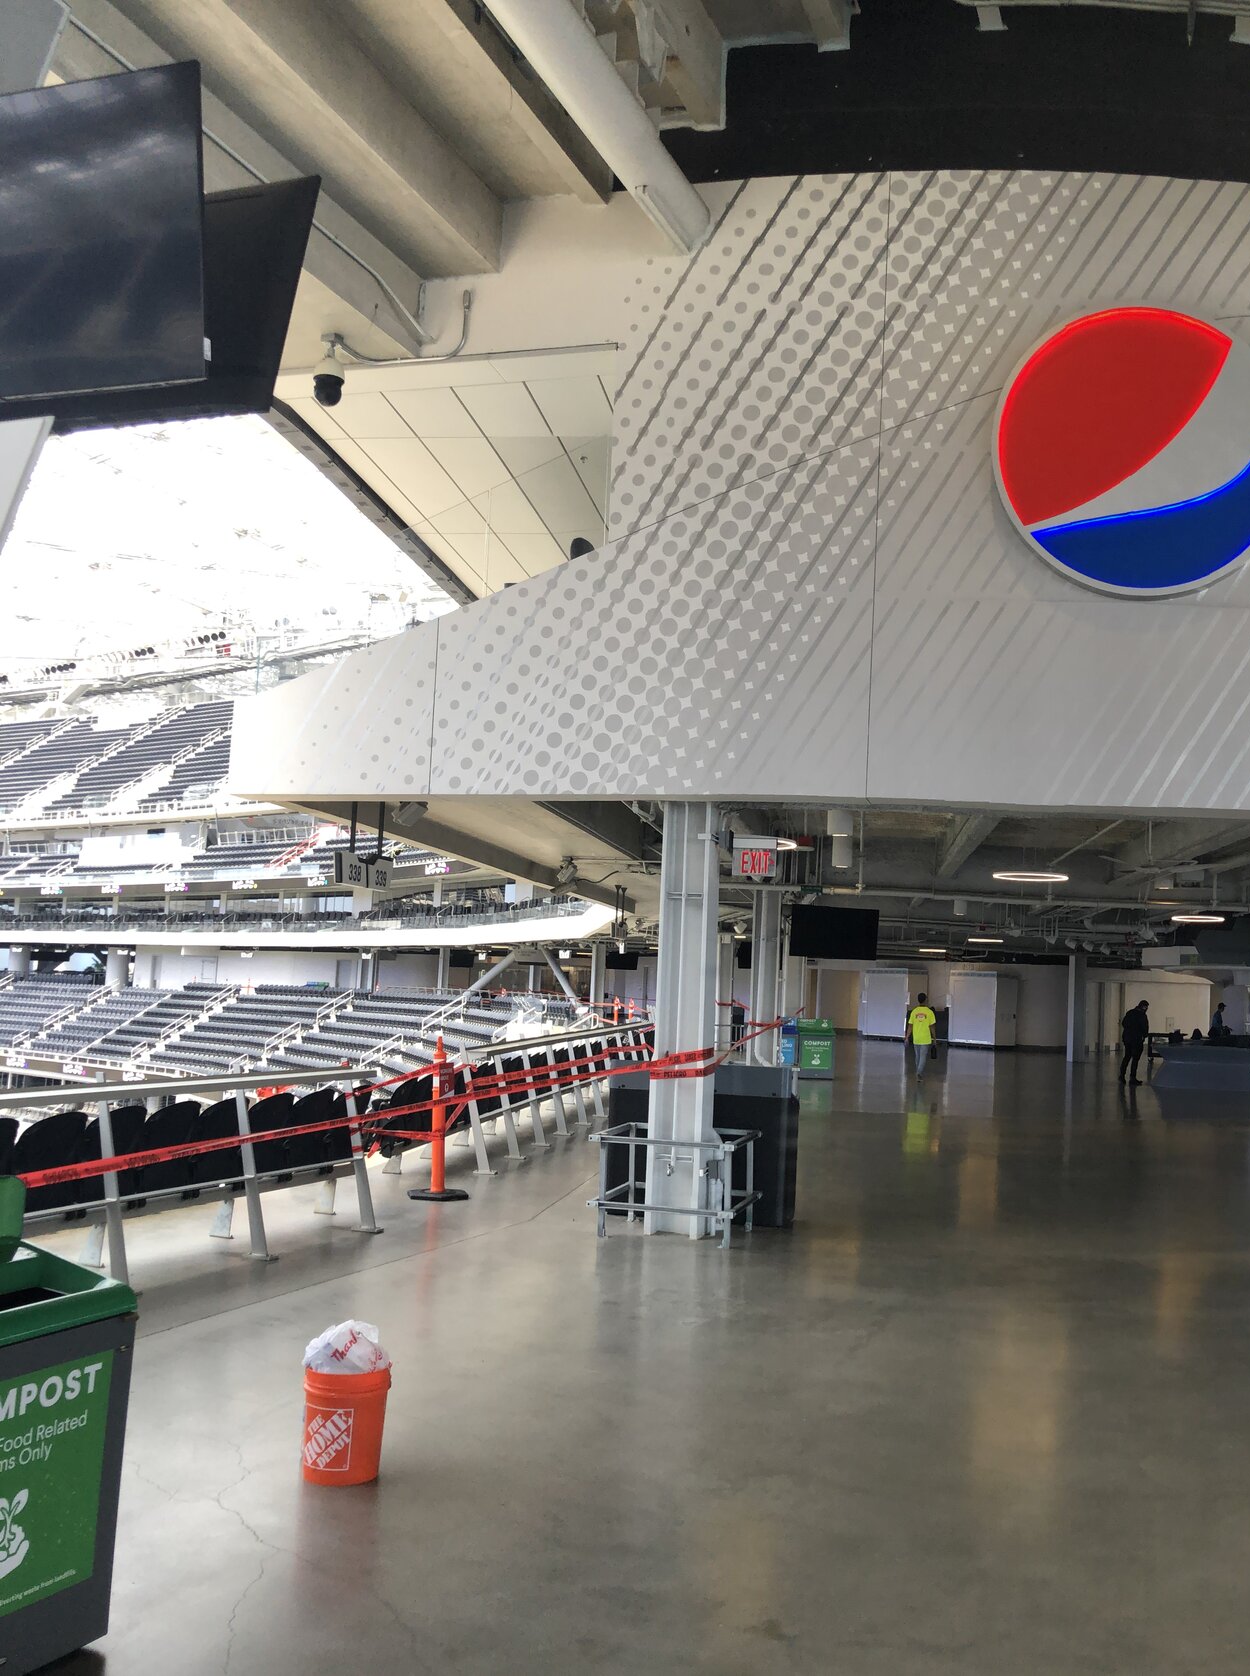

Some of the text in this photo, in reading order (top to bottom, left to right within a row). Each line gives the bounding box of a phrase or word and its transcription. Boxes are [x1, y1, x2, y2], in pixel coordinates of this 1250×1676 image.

[349, 863, 362, 882] 338
[741, 850, 770, 874] EXIT
[375, 869, 388, 887] 339
[36, 1409, 88, 1441] Related
[308, 1414, 325, 1436] THE
[304, 1409, 353, 1466] HOME
[19, 1442, 52, 1465] Only
[316, 1431, 351, 1469] DEPOT
